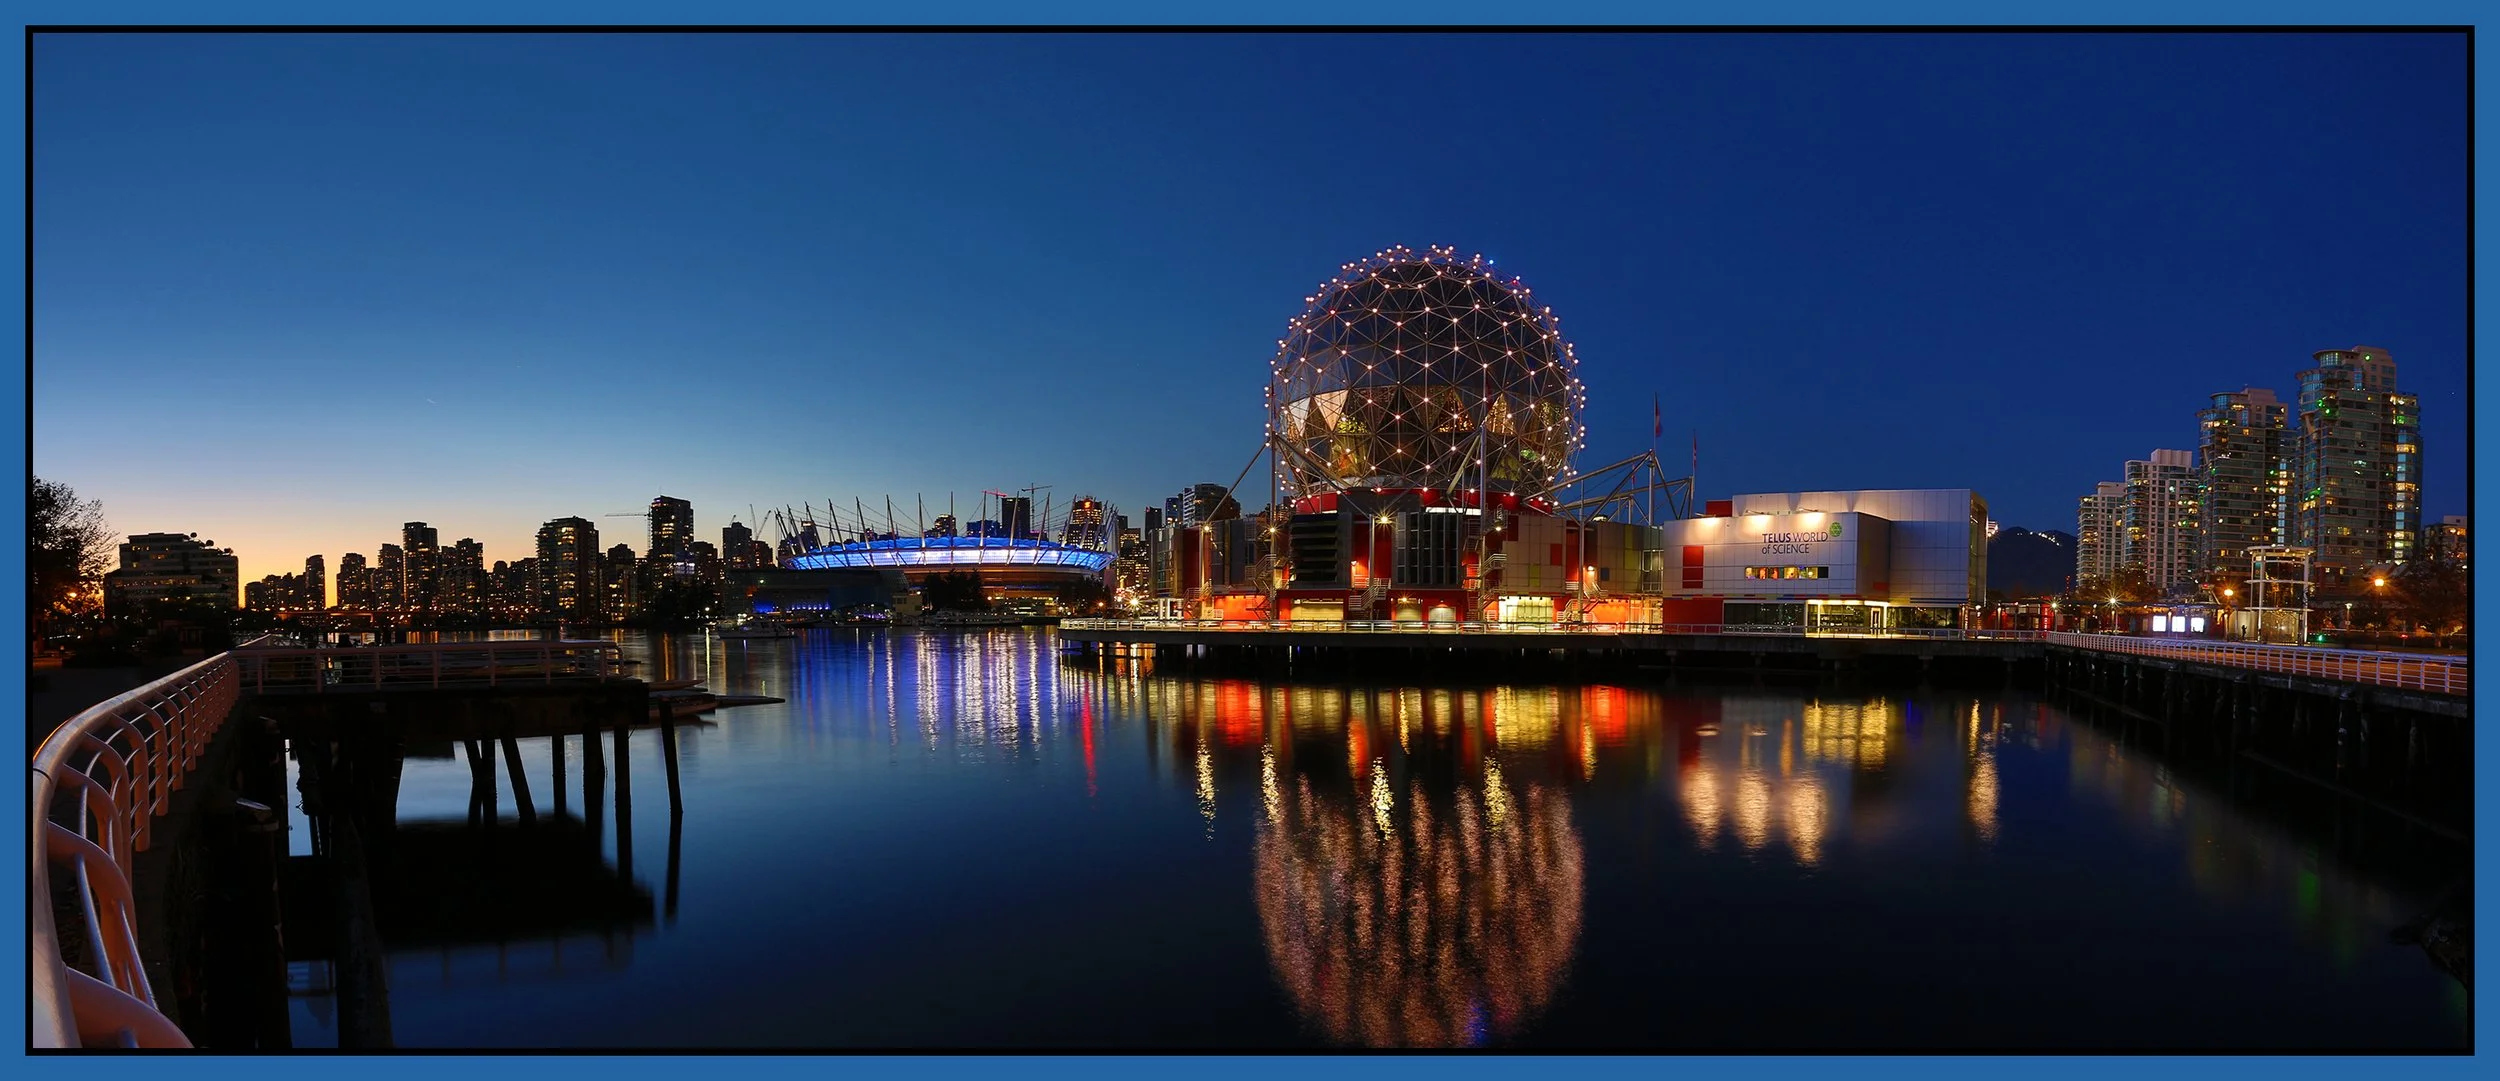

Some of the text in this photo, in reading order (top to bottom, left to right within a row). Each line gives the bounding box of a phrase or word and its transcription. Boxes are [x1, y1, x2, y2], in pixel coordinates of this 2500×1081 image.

[1762, 531, 1828, 543] TELUS WORLD
[1761, 543, 1809, 554] of SCIENCE
